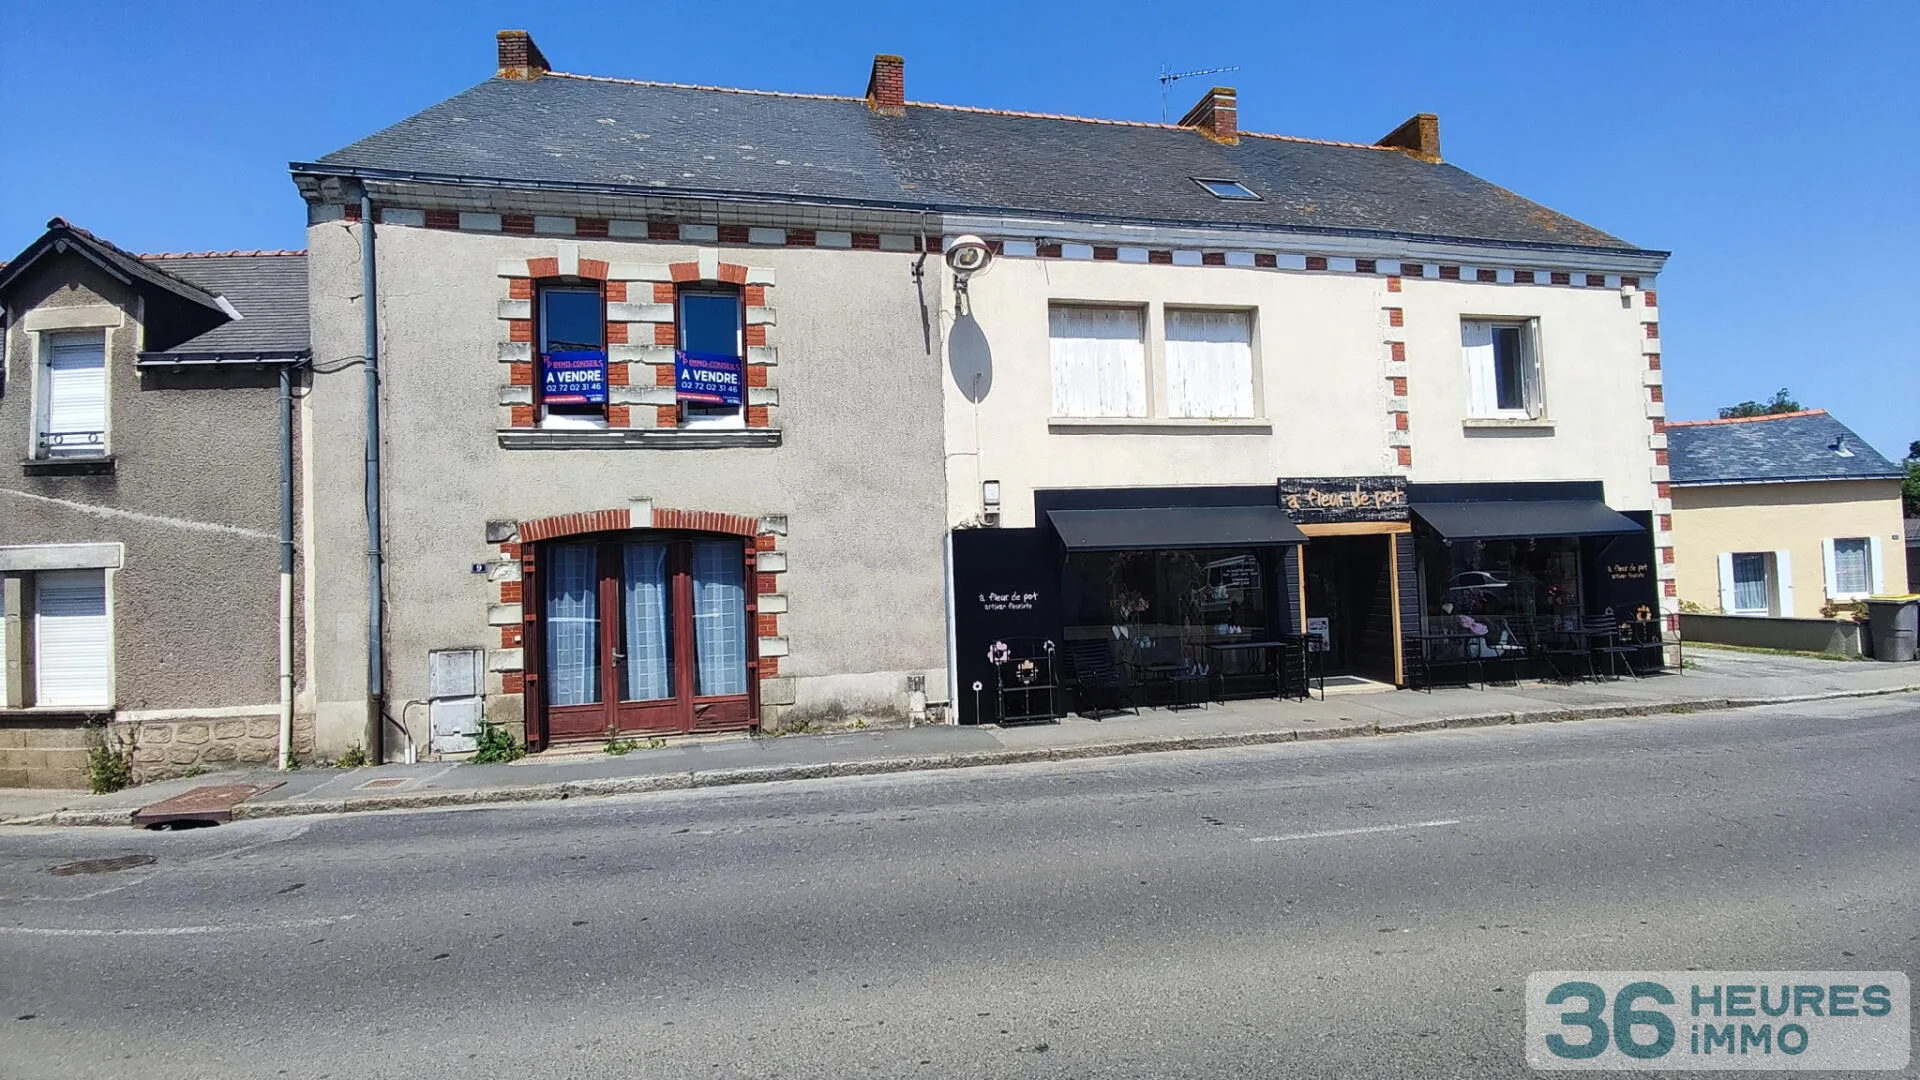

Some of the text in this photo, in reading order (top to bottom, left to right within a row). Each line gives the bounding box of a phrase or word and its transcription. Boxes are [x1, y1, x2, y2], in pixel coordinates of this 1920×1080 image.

[546, 369, 602, 384] A VENDRE
[681, 368, 738, 385] A VENDRE
[546, 382, 602, 392] 02 72 02 31 46
[681, 381, 738, 393] 02 72 02 31 46
[1286, 483, 1404, 509] a fleur de pot
[476, 564, 483, 572] 9
[989, 592, 1010, 602] fleur
[1011, 591, 1021, 601] de
[1023, 591, 1039, 603] pot
